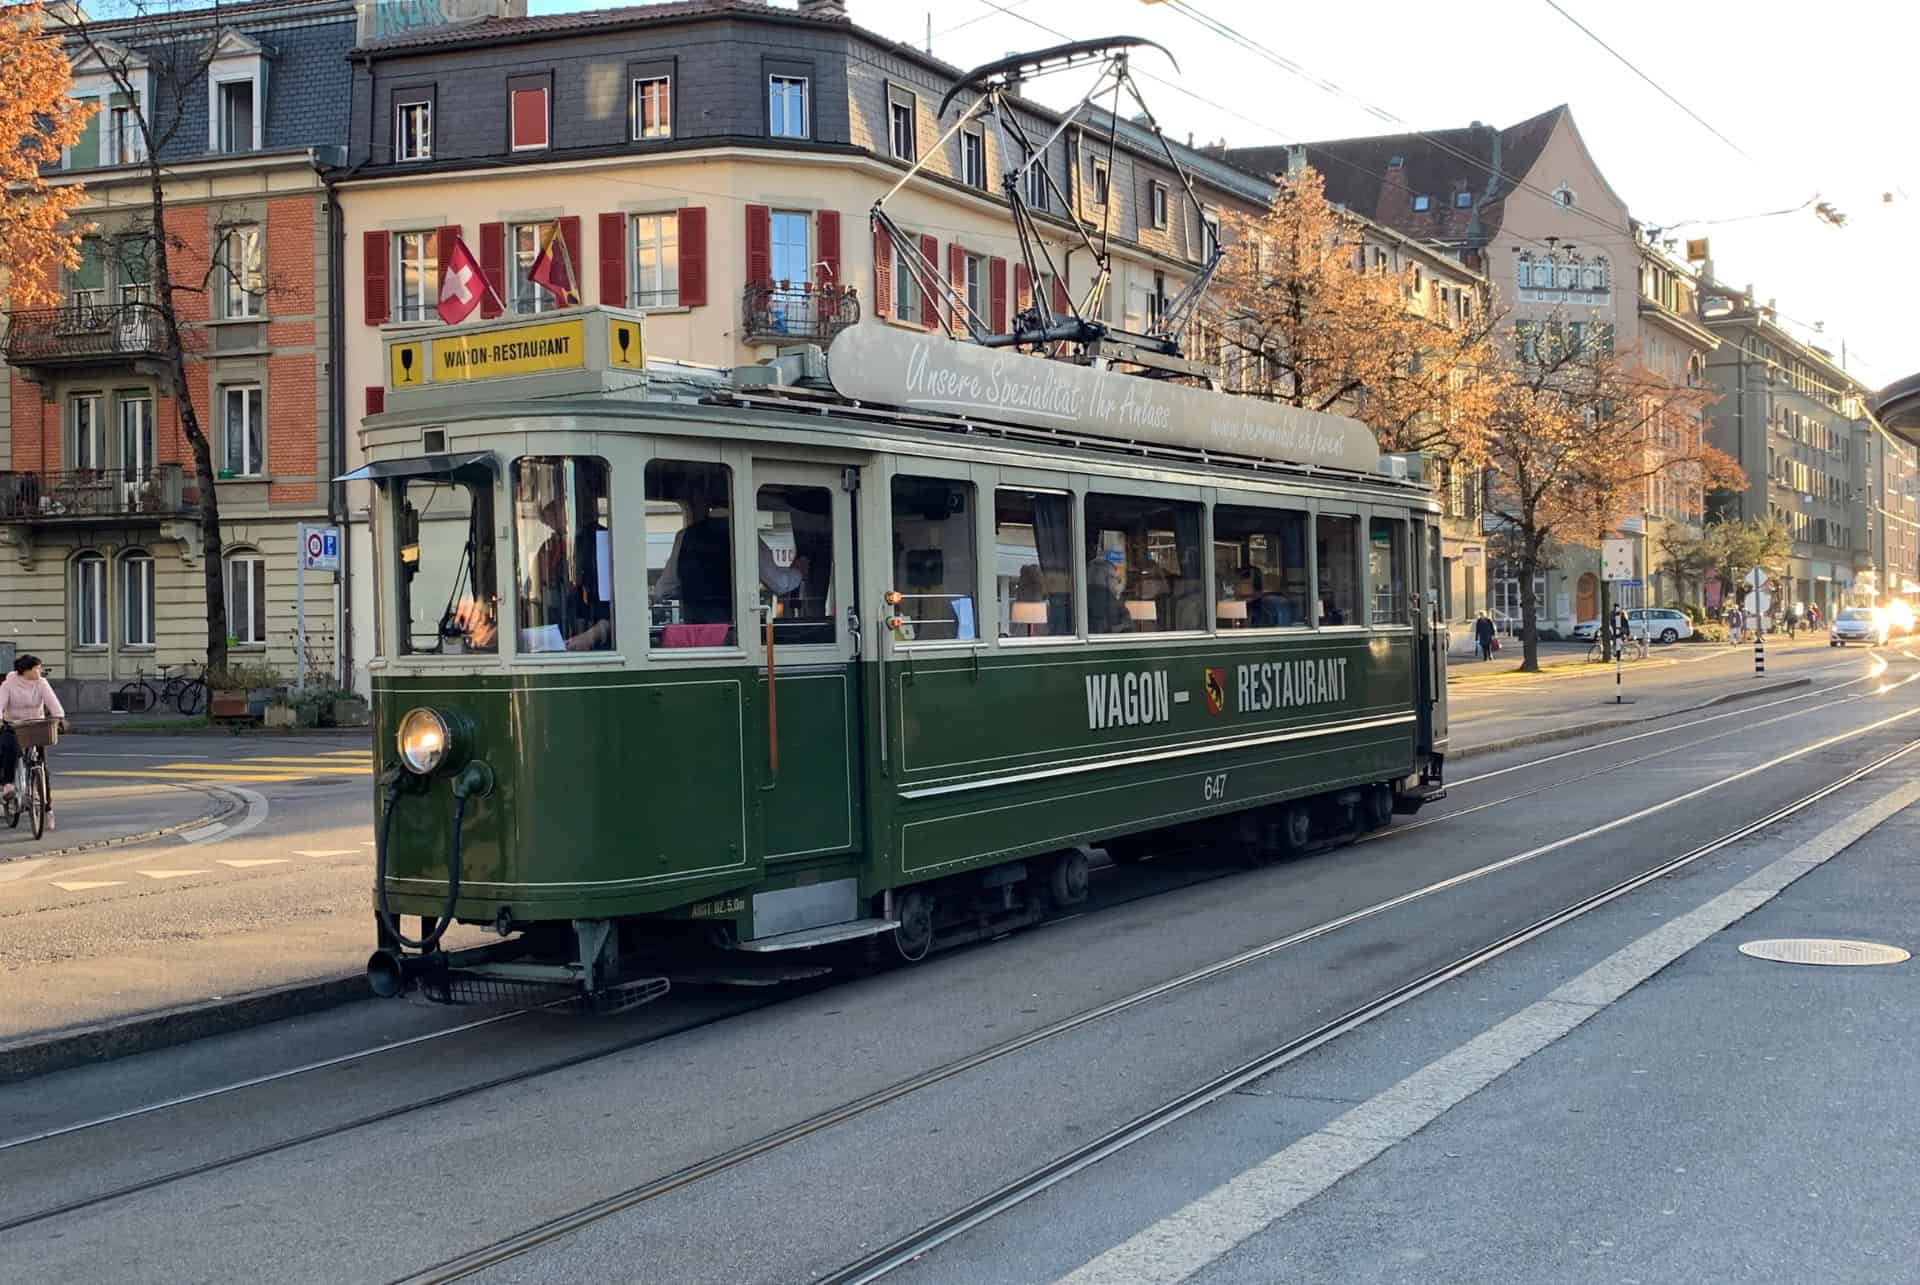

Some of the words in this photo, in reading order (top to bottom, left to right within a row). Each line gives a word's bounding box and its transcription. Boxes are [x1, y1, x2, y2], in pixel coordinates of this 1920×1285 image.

[905, 343, 981, 398] Unsere
[1237, 657, 1347, 712] RESTAURANT
[1204, 774, 1227, 801] 647
